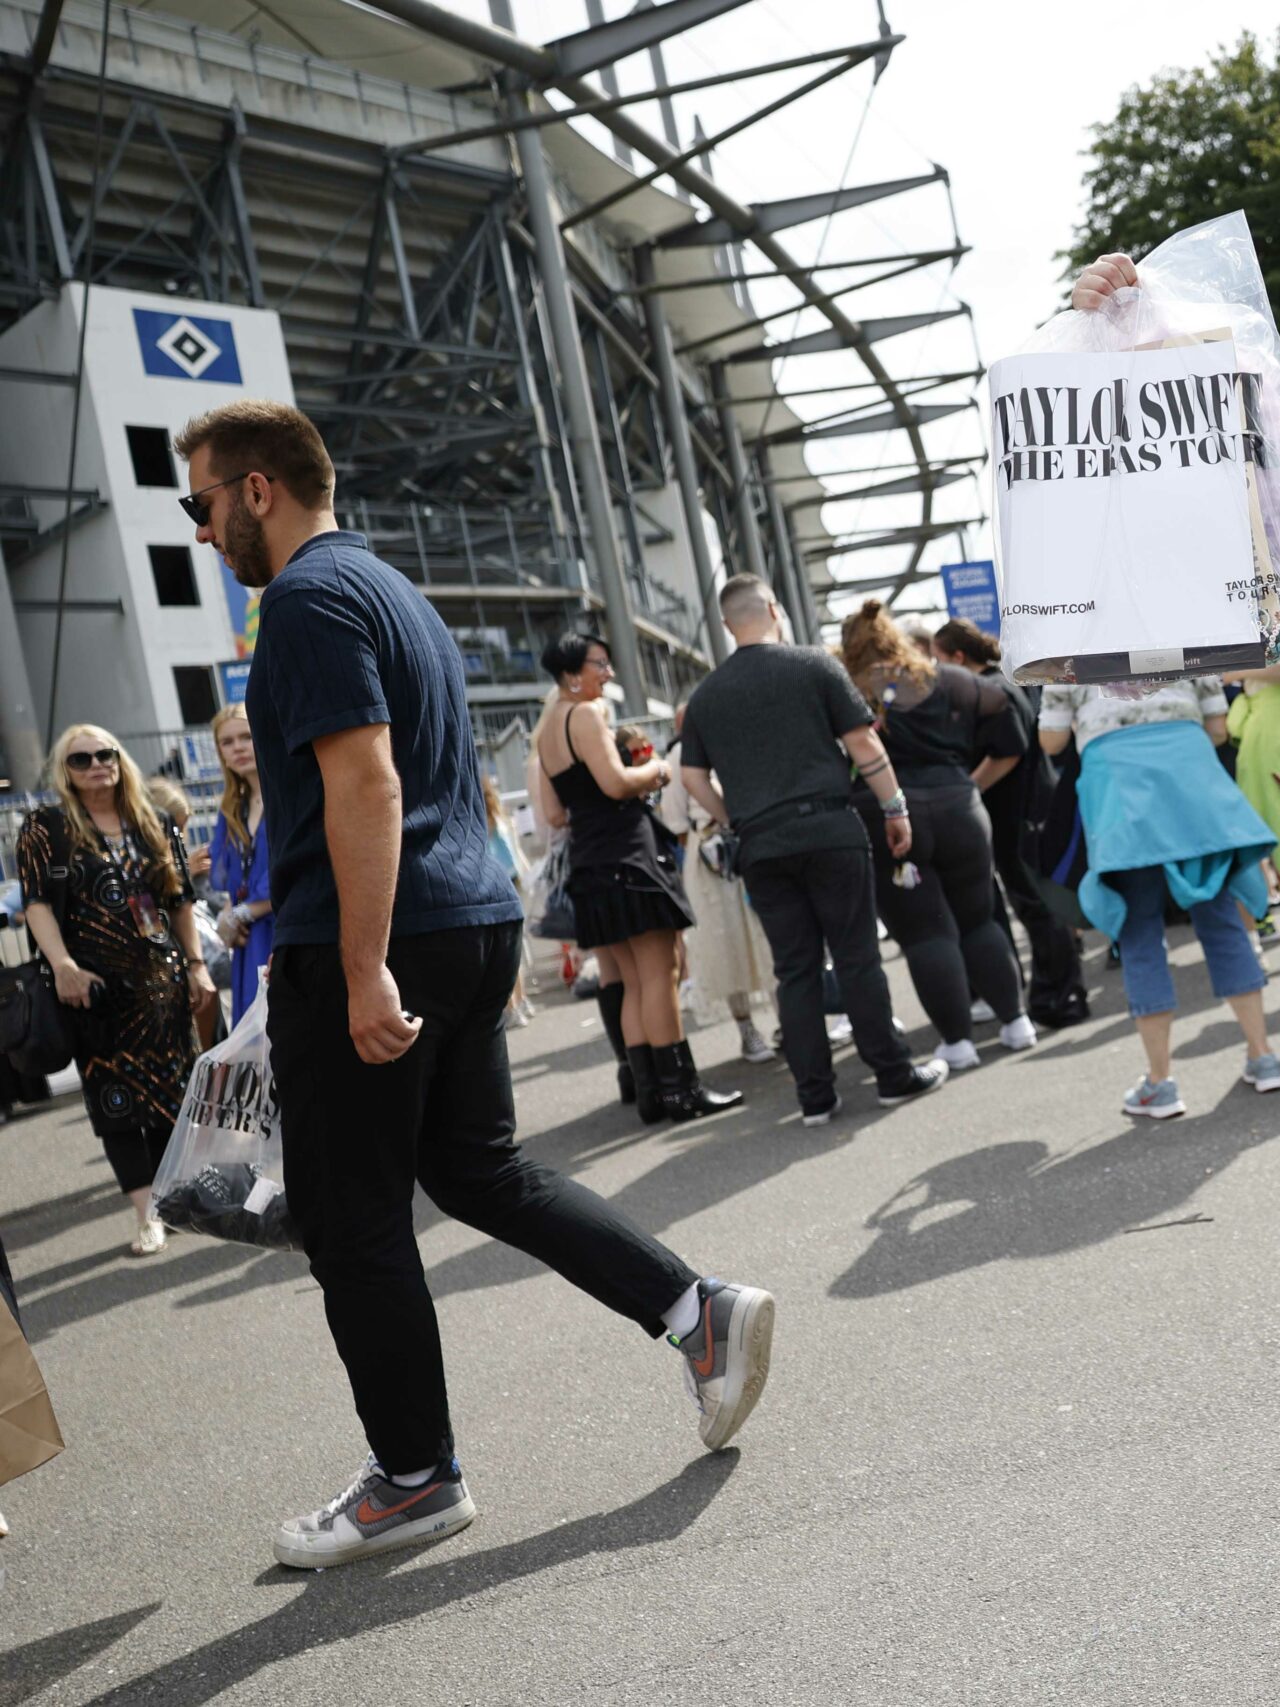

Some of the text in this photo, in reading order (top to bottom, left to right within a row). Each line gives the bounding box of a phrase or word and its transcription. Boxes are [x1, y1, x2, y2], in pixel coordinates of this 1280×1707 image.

[999, 450, 1064, 491] THE
[1170, 433, 1266, 469] TOUR
[1225, 575, 1264, 592] TAYLOR
